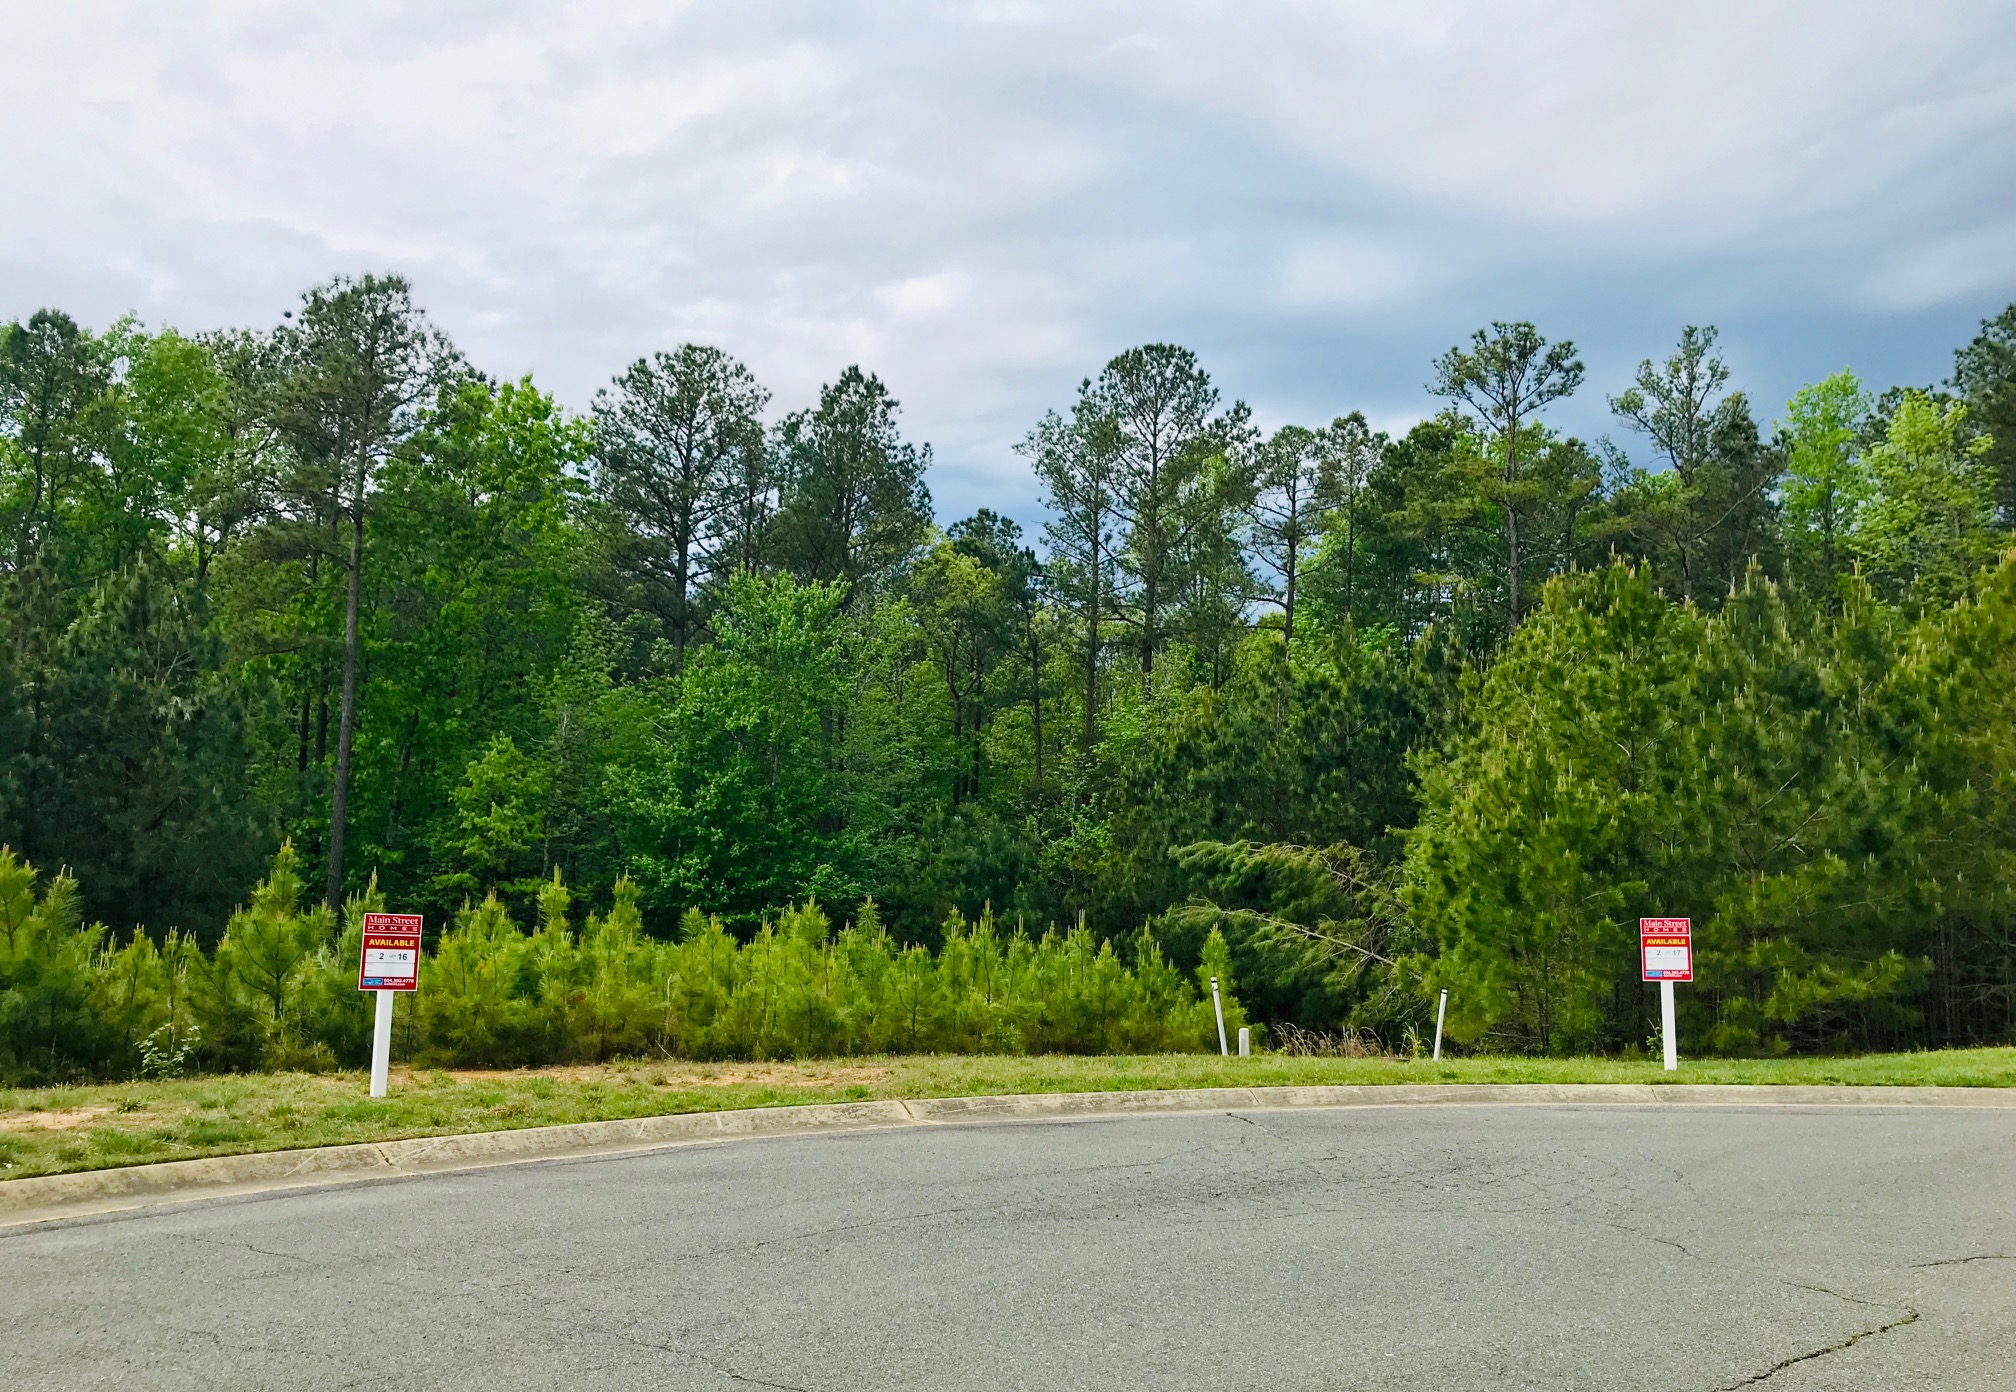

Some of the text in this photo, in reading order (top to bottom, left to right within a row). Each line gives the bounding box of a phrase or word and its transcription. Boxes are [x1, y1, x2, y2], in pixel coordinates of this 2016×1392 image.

[368, 916, 418, 924] Main Street
[368, 938, 415, 946] AVAILABLE
